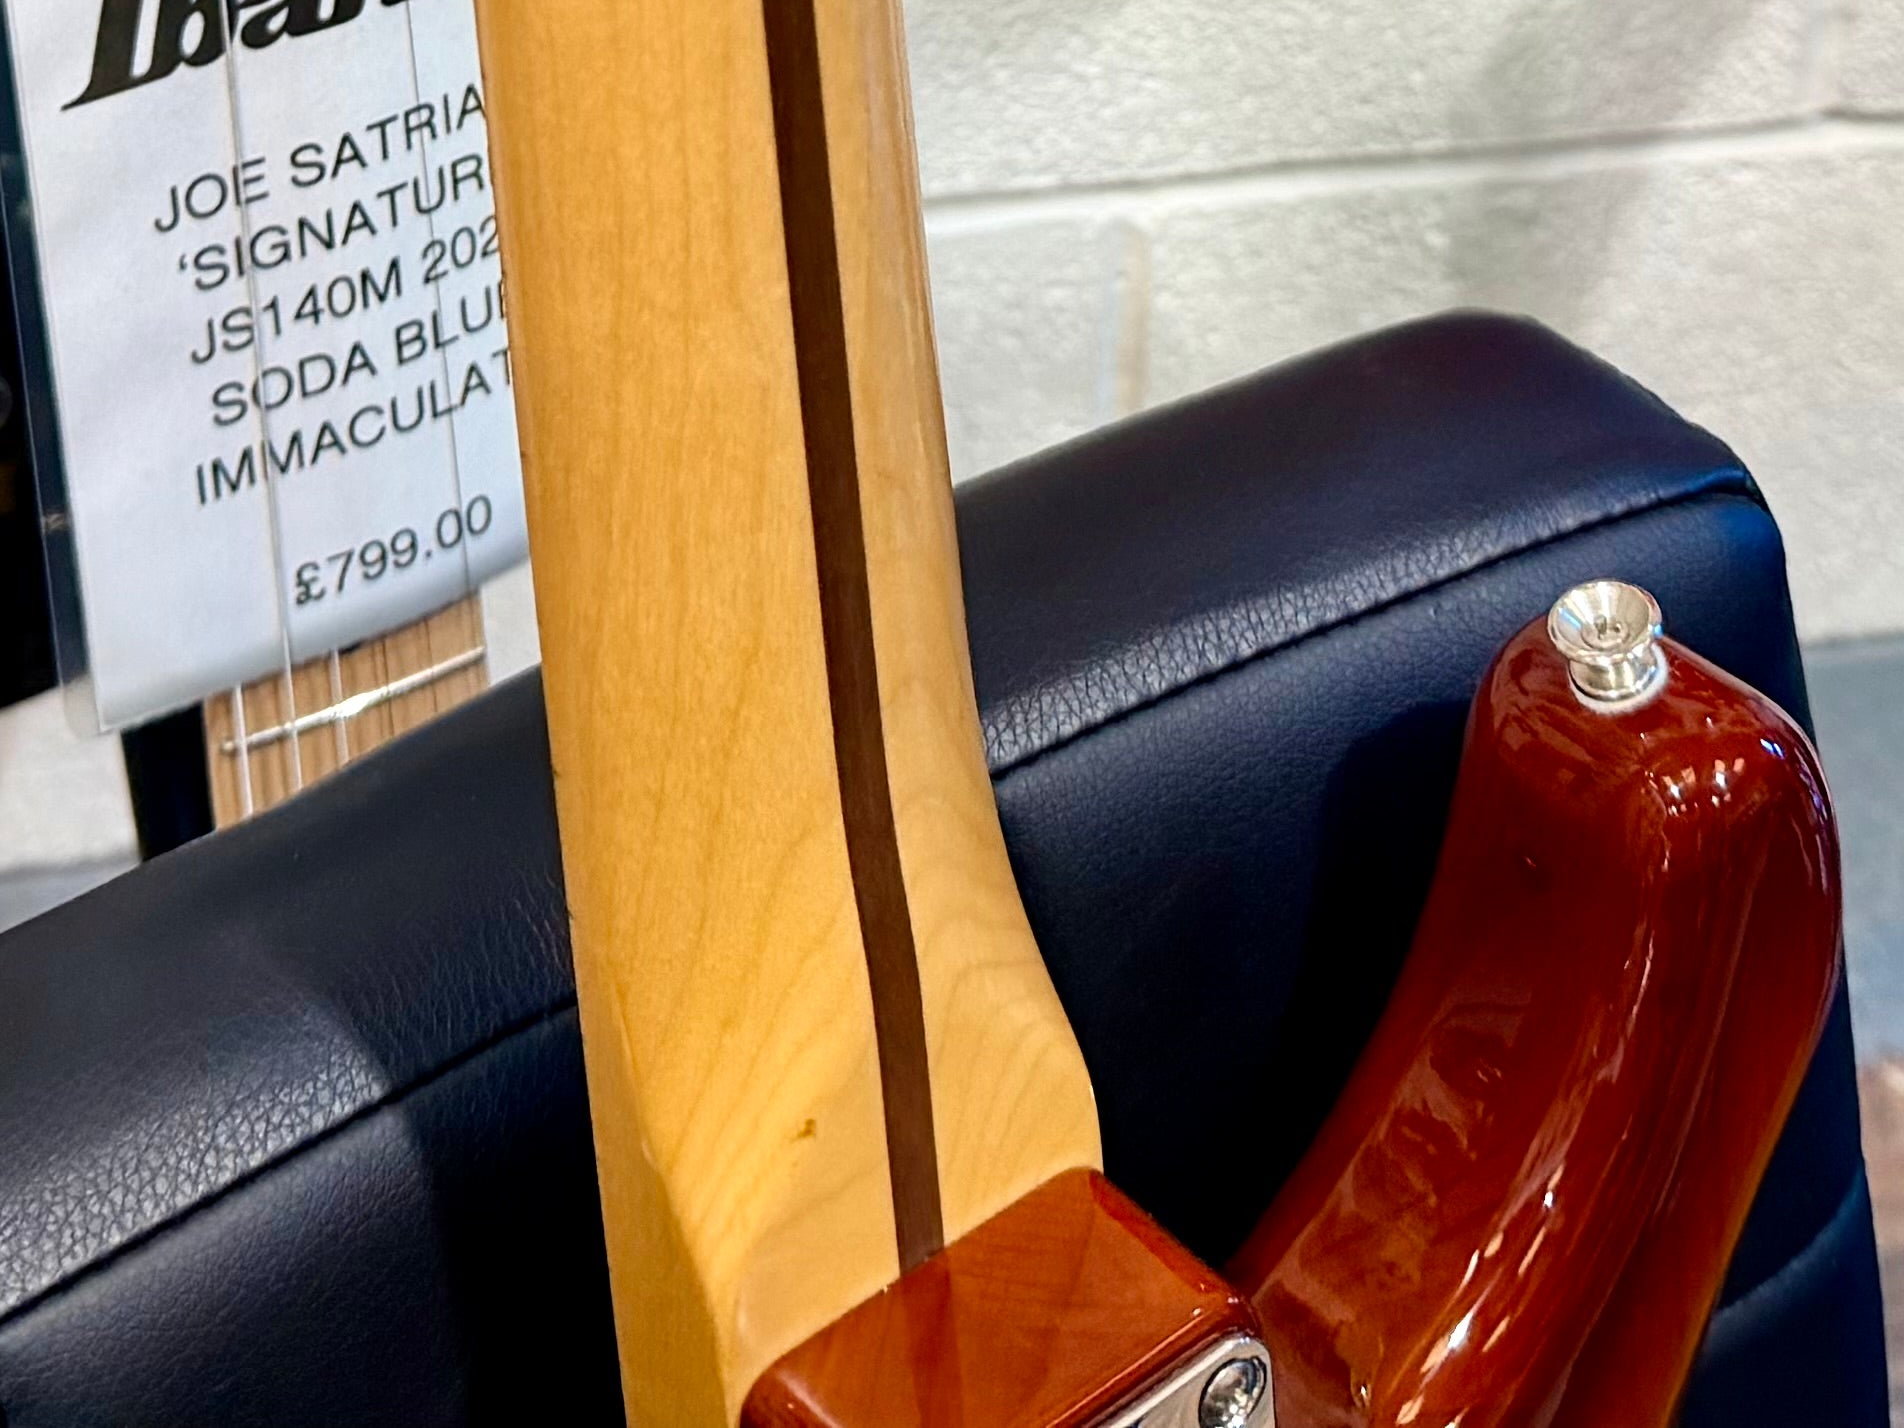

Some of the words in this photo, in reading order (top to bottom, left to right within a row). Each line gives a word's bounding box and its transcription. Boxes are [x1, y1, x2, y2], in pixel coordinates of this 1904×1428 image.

[154, 157, 270, 234] JOE
[190, 265, 402, 366] JS140M
[211, 351, 377, 427] SODA
[295, 495, 493, 607] £799.00
